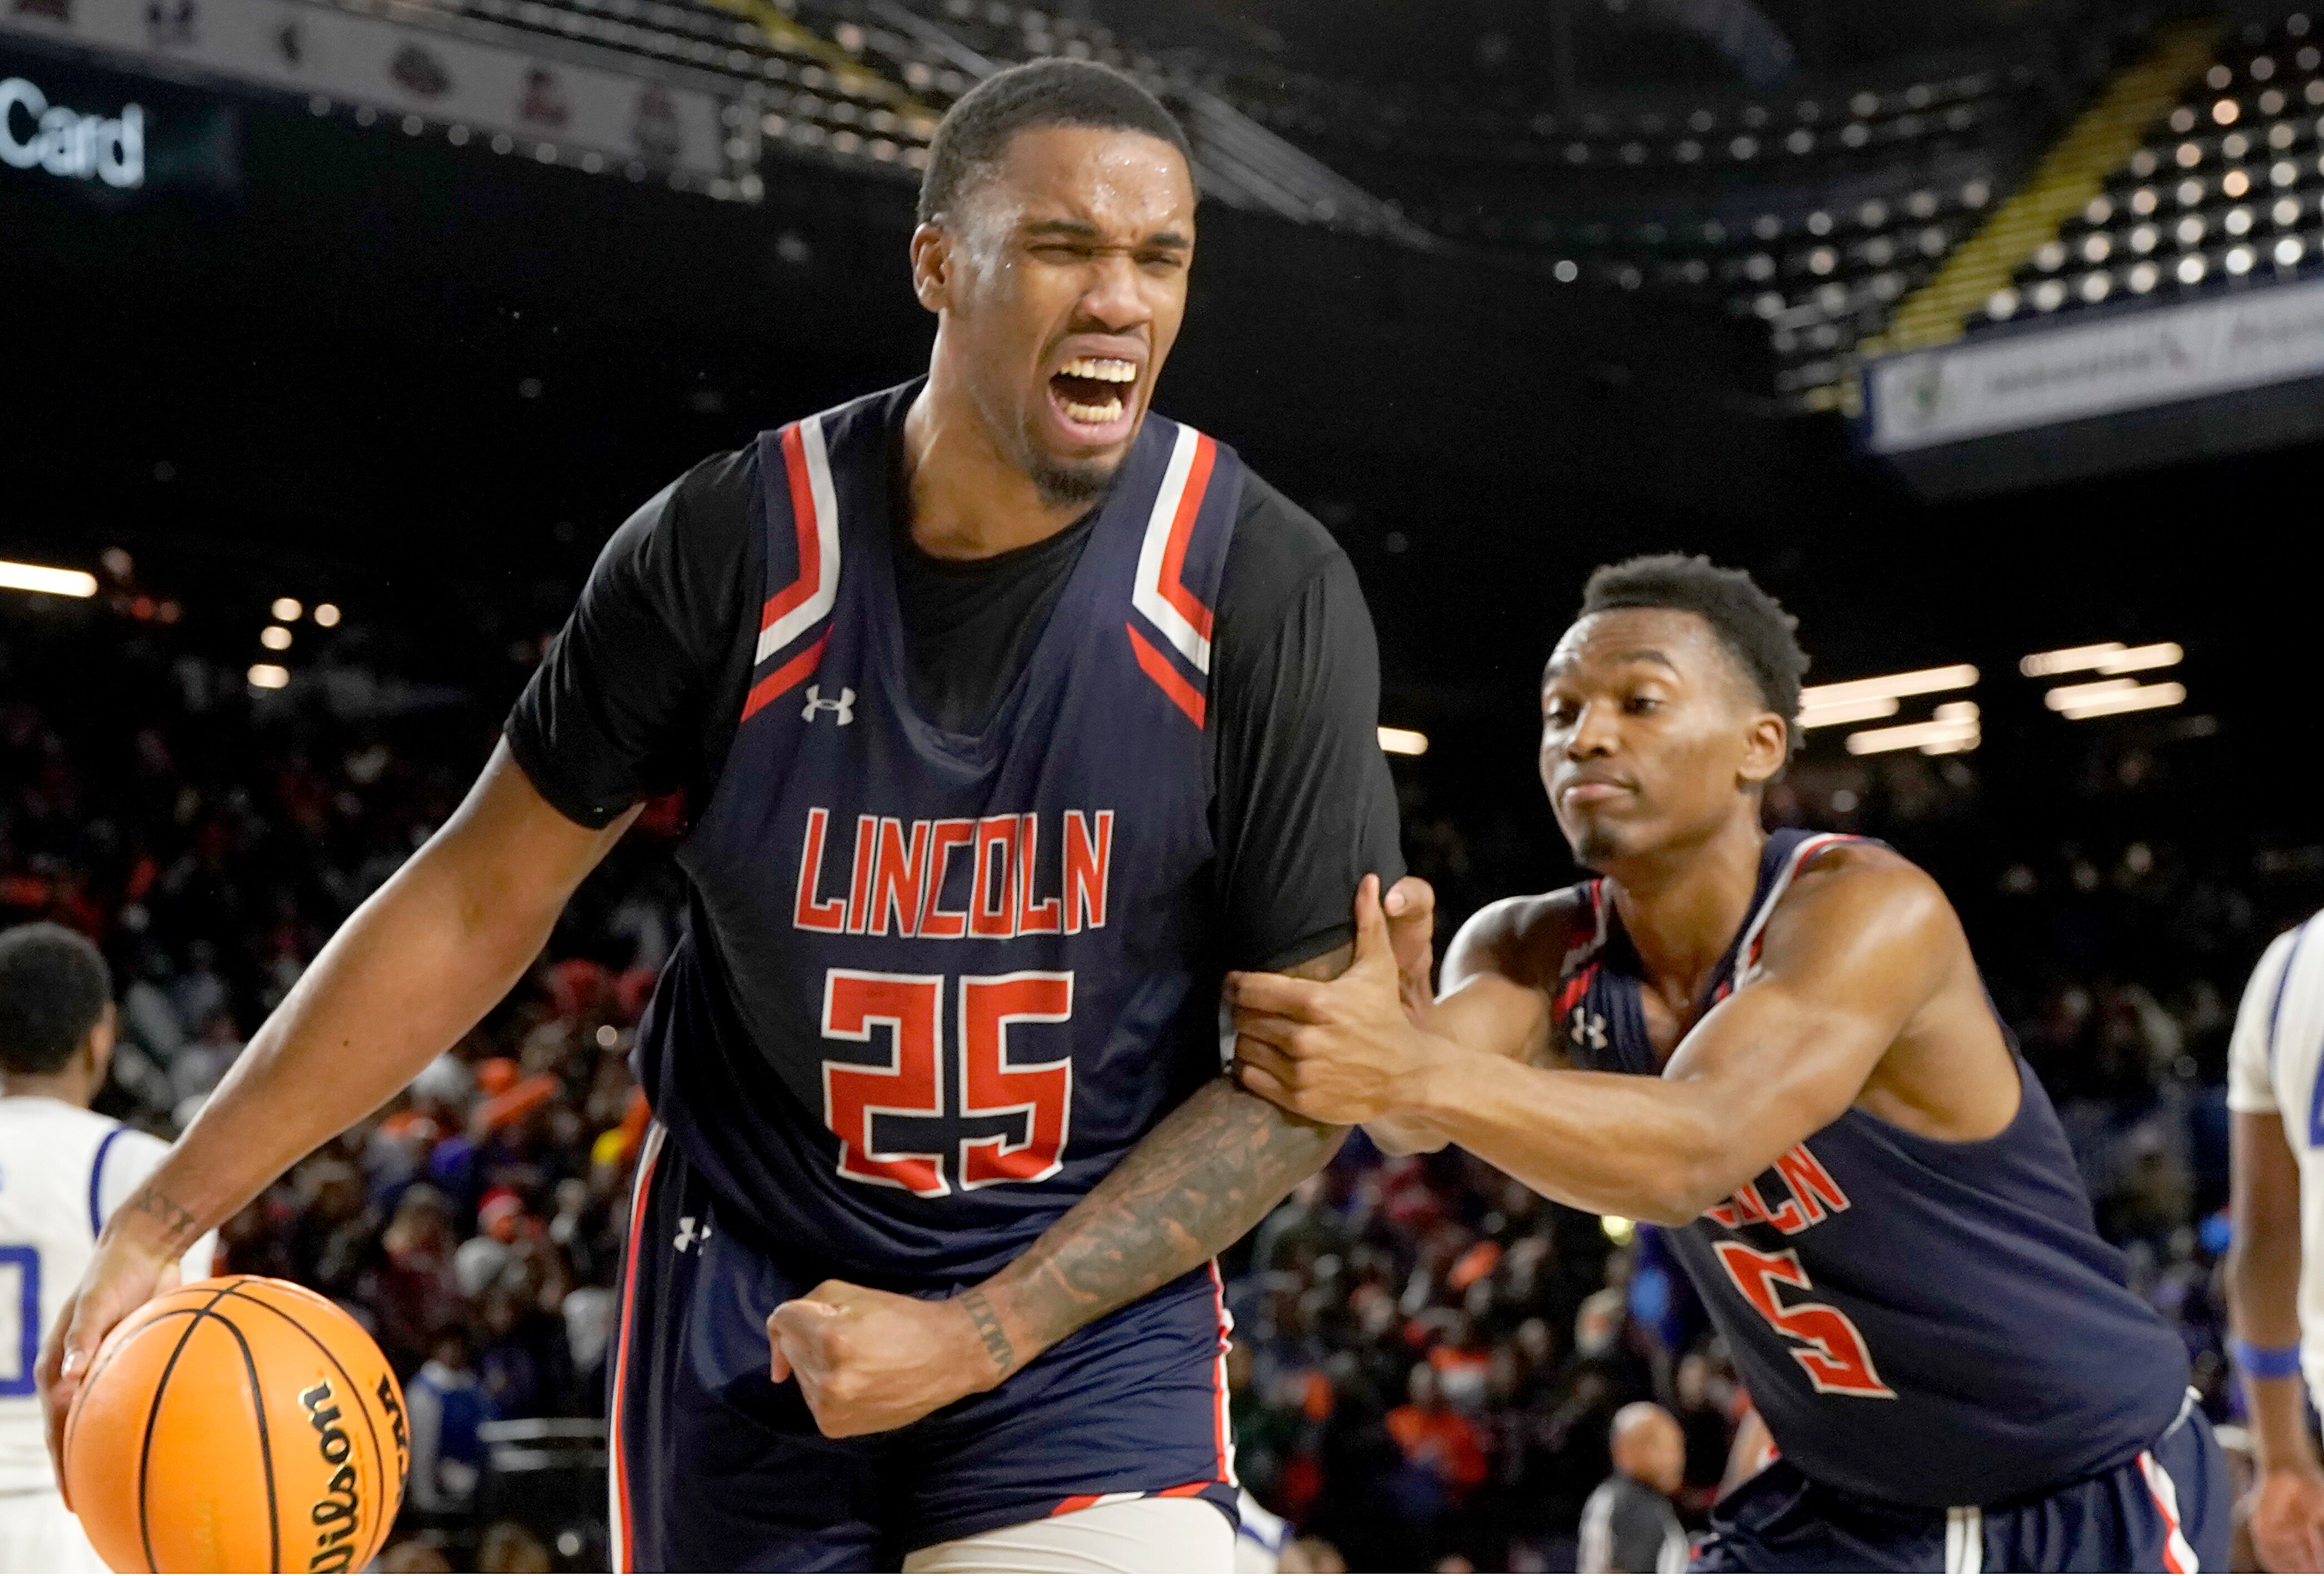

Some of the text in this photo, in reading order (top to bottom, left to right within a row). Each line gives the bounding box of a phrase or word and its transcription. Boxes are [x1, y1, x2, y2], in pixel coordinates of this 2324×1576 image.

[0, 77, 145, 189] Card
[793, 807, 1114, 938] LINCOLN
[821, 968, 1074, 1199] 25
[1712, 1240, 1899, 1401] 5
